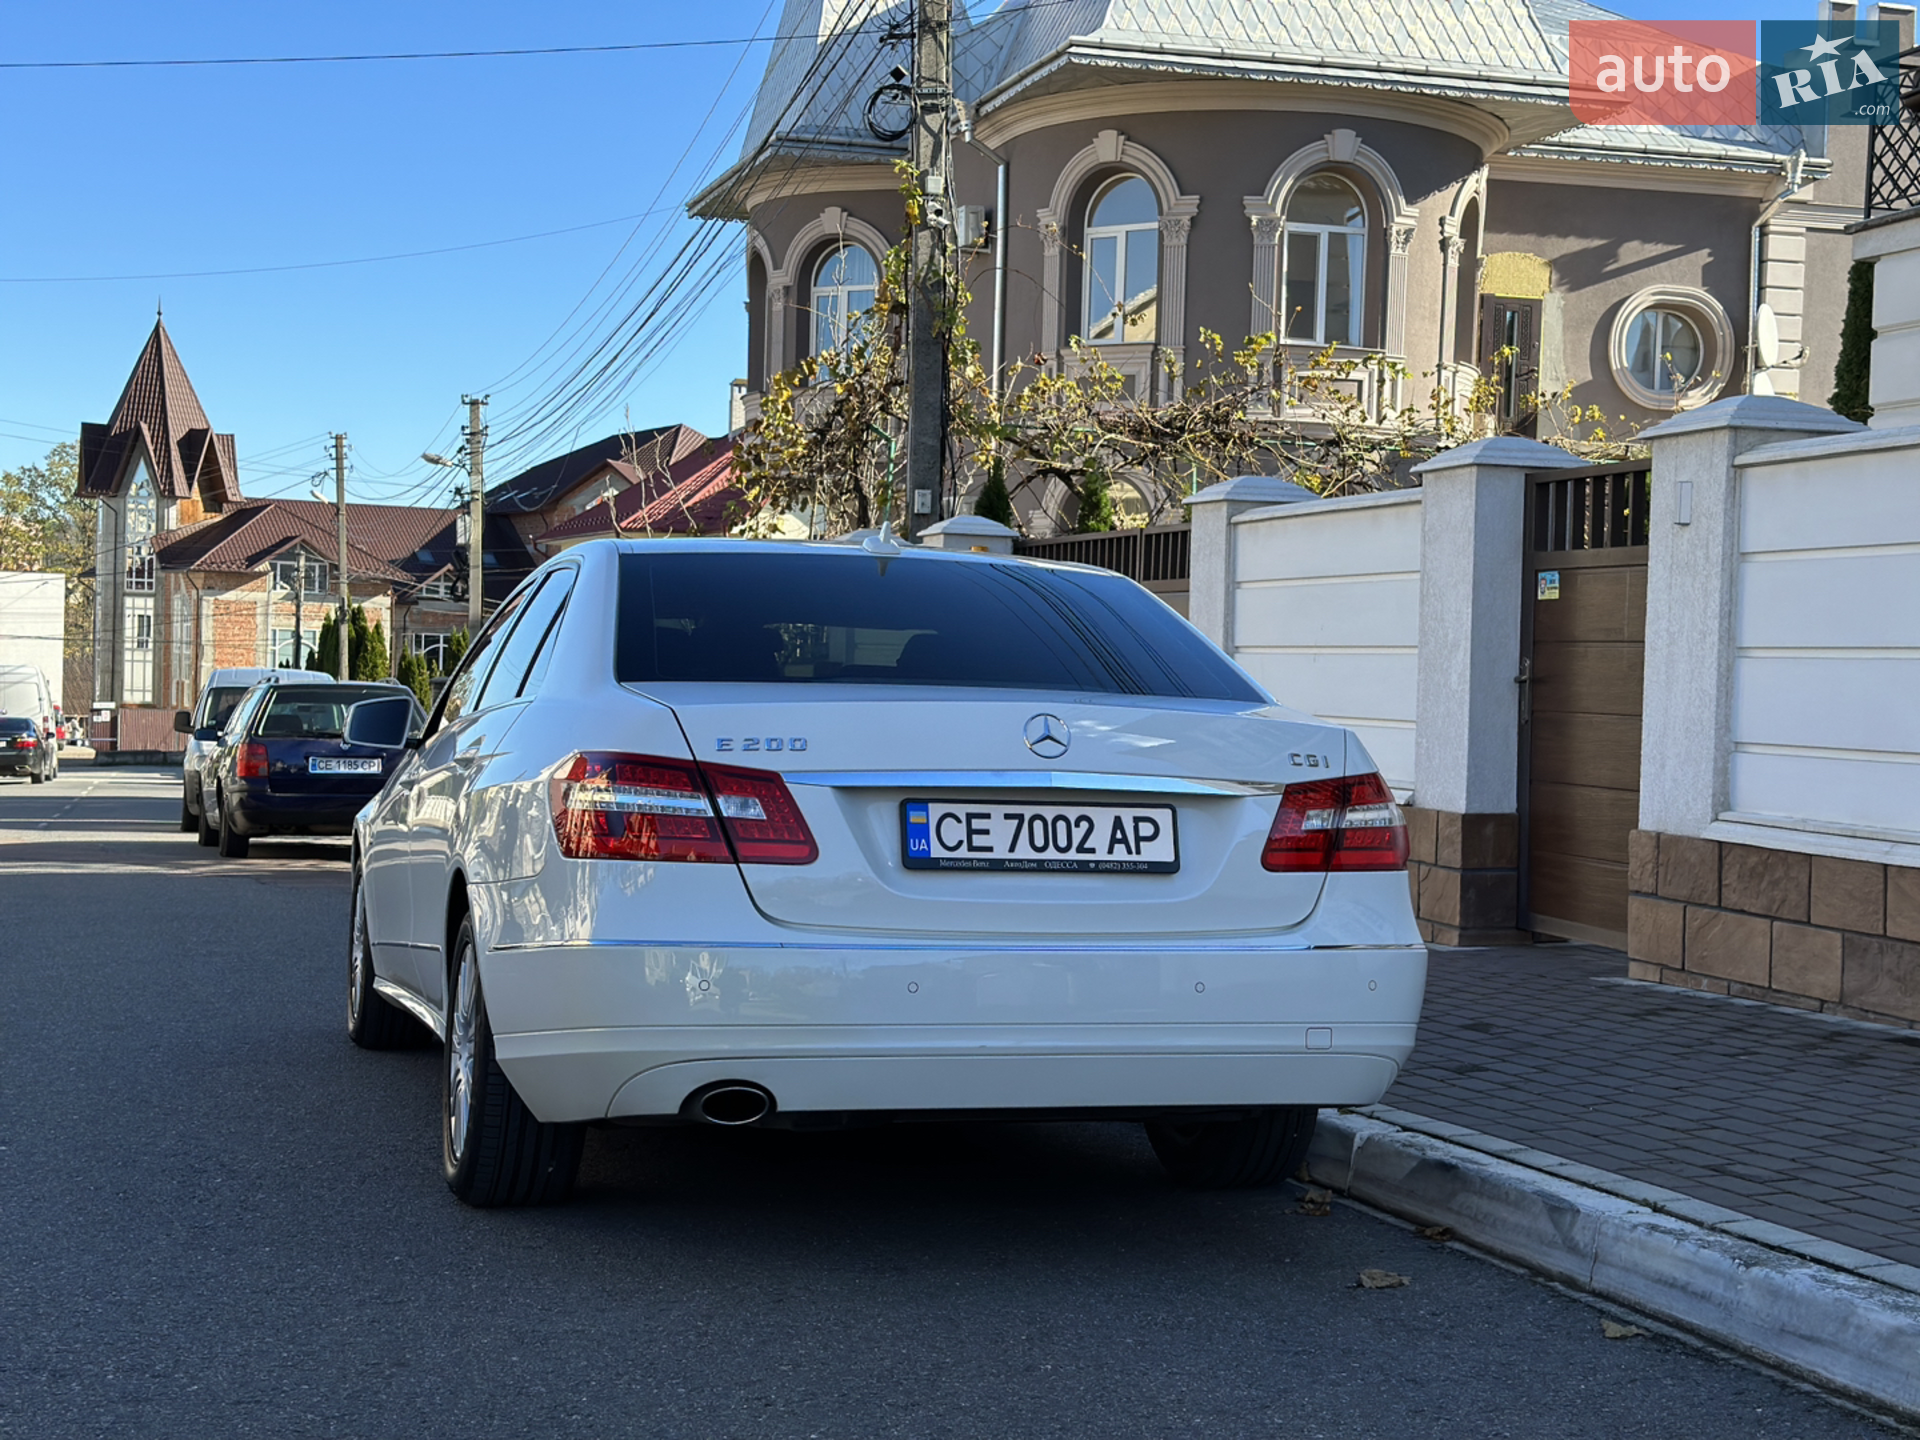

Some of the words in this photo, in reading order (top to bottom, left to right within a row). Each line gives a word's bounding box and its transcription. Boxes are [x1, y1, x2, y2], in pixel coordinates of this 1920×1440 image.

[317, 759, 333, 771] CE
[1288, 752, 1330, 769] CGI
[935, 811, 994, 852] CE
[1003, 812, 1096, 854] 7002
[1107, 815, 1161, 856] AP
[910, 838, 929, 851] UA
